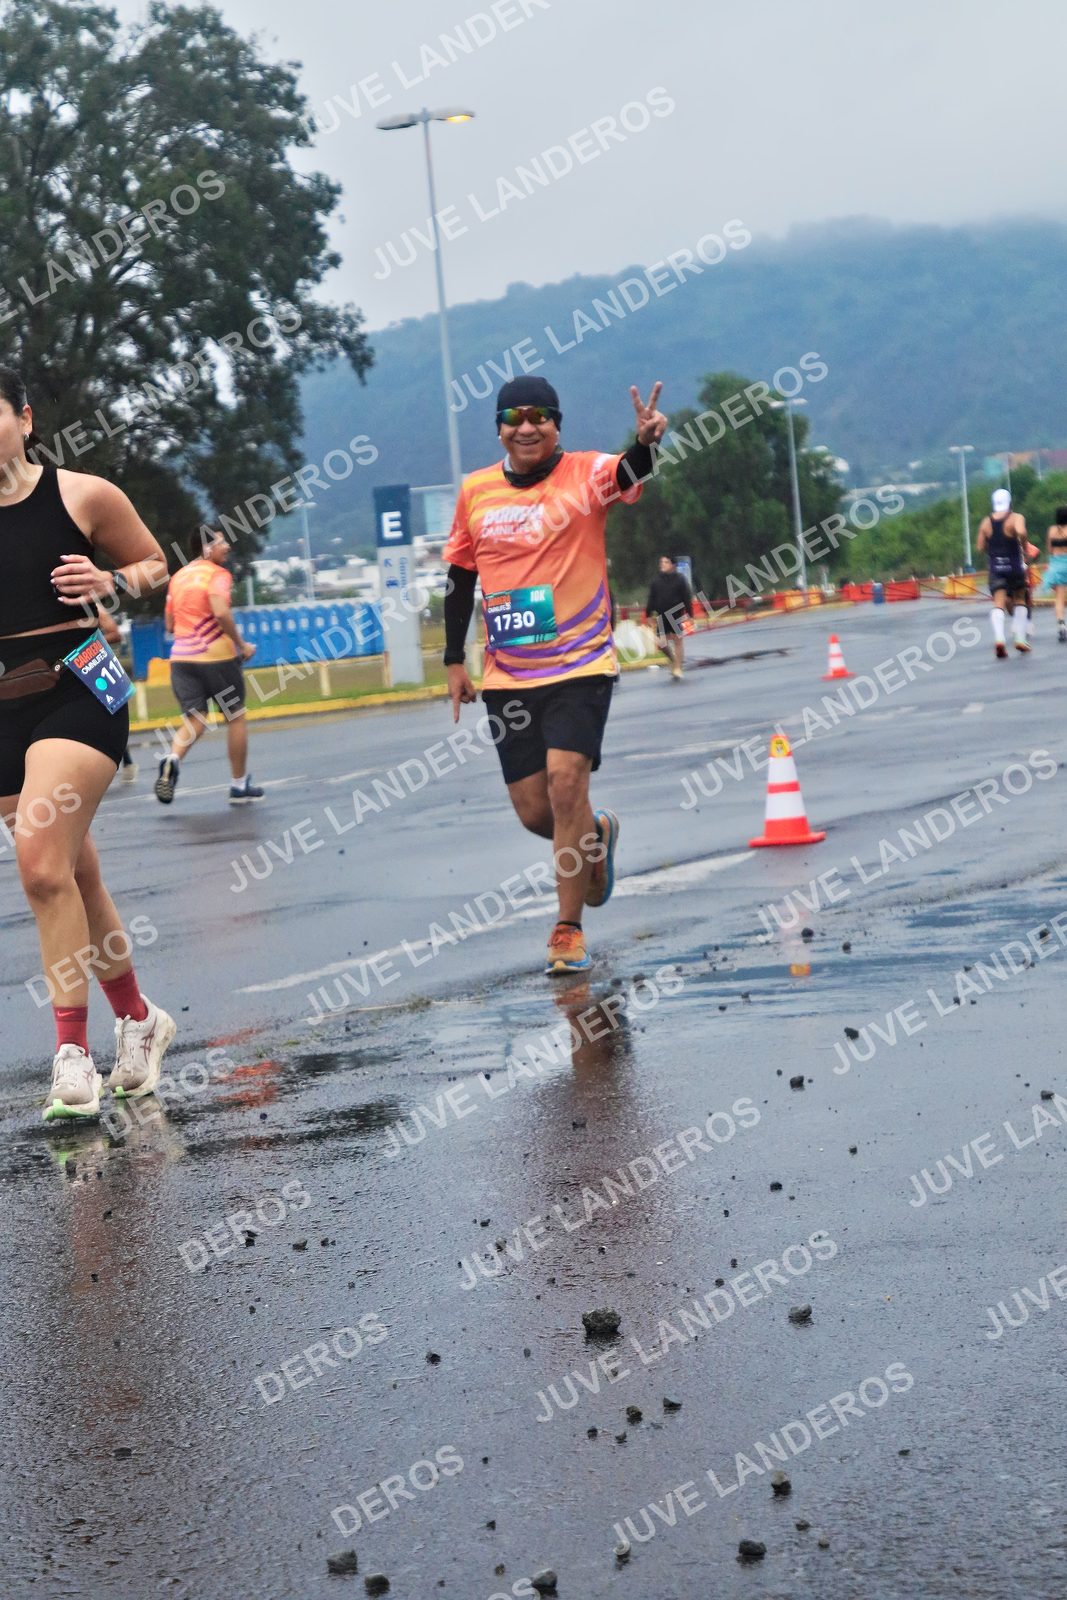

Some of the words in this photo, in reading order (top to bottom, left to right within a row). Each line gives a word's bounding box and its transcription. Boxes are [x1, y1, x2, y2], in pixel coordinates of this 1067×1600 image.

[381, 510, 403, 539] E
[530, 589, 546, 603] 10K
[494, 610, 535, 632] 1730
